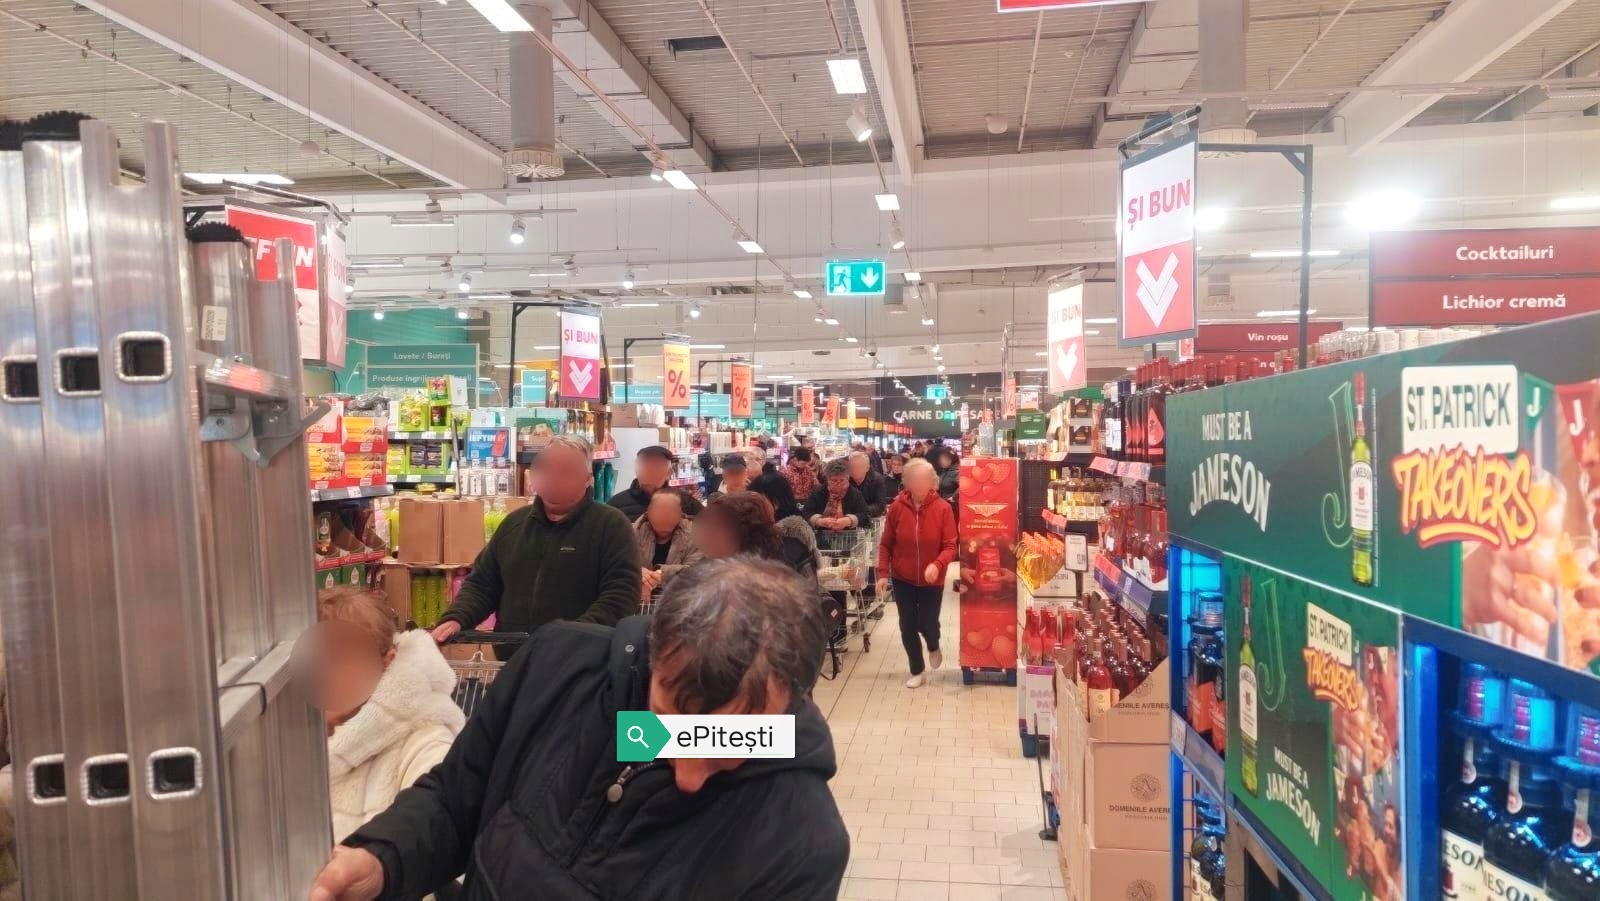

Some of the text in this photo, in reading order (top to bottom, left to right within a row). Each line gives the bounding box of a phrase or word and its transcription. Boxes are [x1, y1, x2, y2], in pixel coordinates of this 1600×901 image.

[1127, 179, 1191, 230] ȘI BUN
[1455, 245, 1554, 261] Cocktailuri
[1062, 303, 1082, 322] BUN
[1442, 293, 1567, 310] Lichior cremă
[564, 329, 598, 345] ȘI BUN
[1247, 331, 1289, 343] Vin roșu
[393, 352, 420, 360] Lavete
[668, 369, 687, 399] %
[893, 410, 932, 420] CARNE
[1406, 382, 1511, 432] ST. PATRICK
[1526, 387, 1541, 418] J
[1569, 399, 1585, 436] J
[1202, 410, 1252, 441] MUST BE A
[1189, 453, 1271, 533] JAMESON
[1391, 441, 1538, 548] TAKEOVERS
[1320, 619, 1350, 653] PATRICK
[1302, 646, 1360, 712] TAKEOVERS
[1274, 746, 1309, 790] MUST BE A
[1266, 772, 1320, 847] JAMESON
